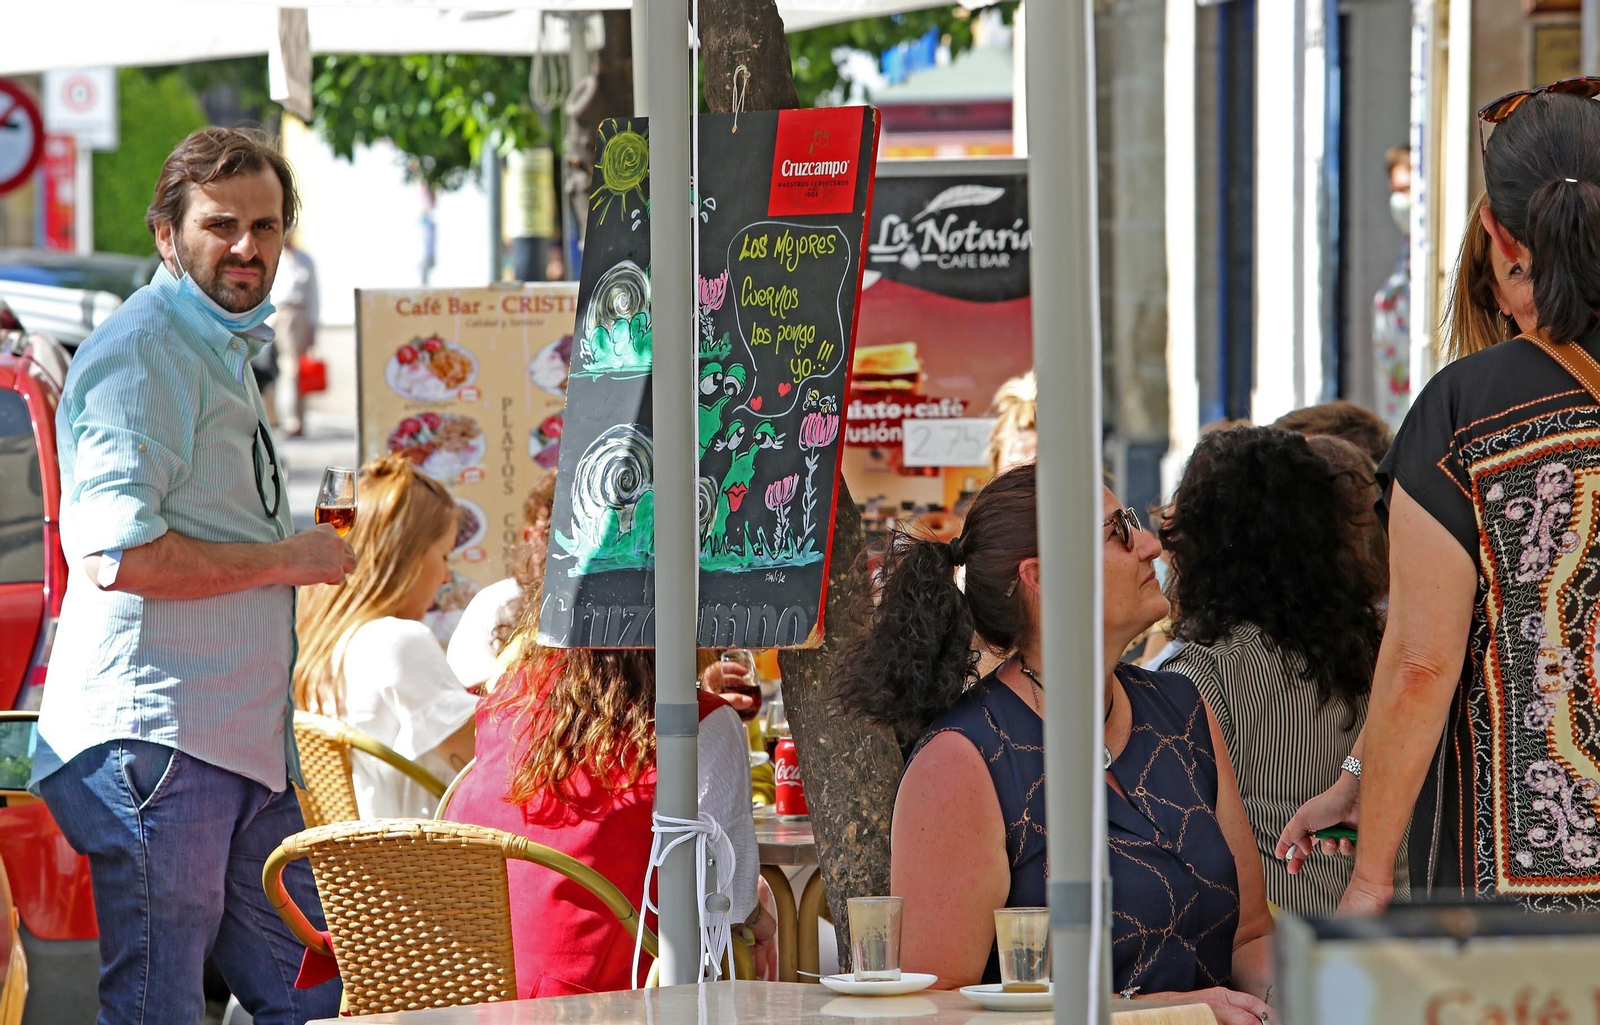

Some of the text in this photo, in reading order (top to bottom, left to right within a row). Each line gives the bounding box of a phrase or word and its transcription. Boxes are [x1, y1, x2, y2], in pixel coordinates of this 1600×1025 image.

[781, 159, 848, 178] Cruzcampo
[777, 180, 809, 188] MAESTROS
[811, 179, 849, 187] CERVECEROS
[868, 214, 914, 254] La
[937, 253, 1010, 270] CAFE BAR
[395, 296, 442, 317] Café
[448, 297, 480, 315] Bar
[847, 398, 965, 421] ixto+café
[845, 422, 903, 443] usión
[501, 397, 516, 495] PLATOS
